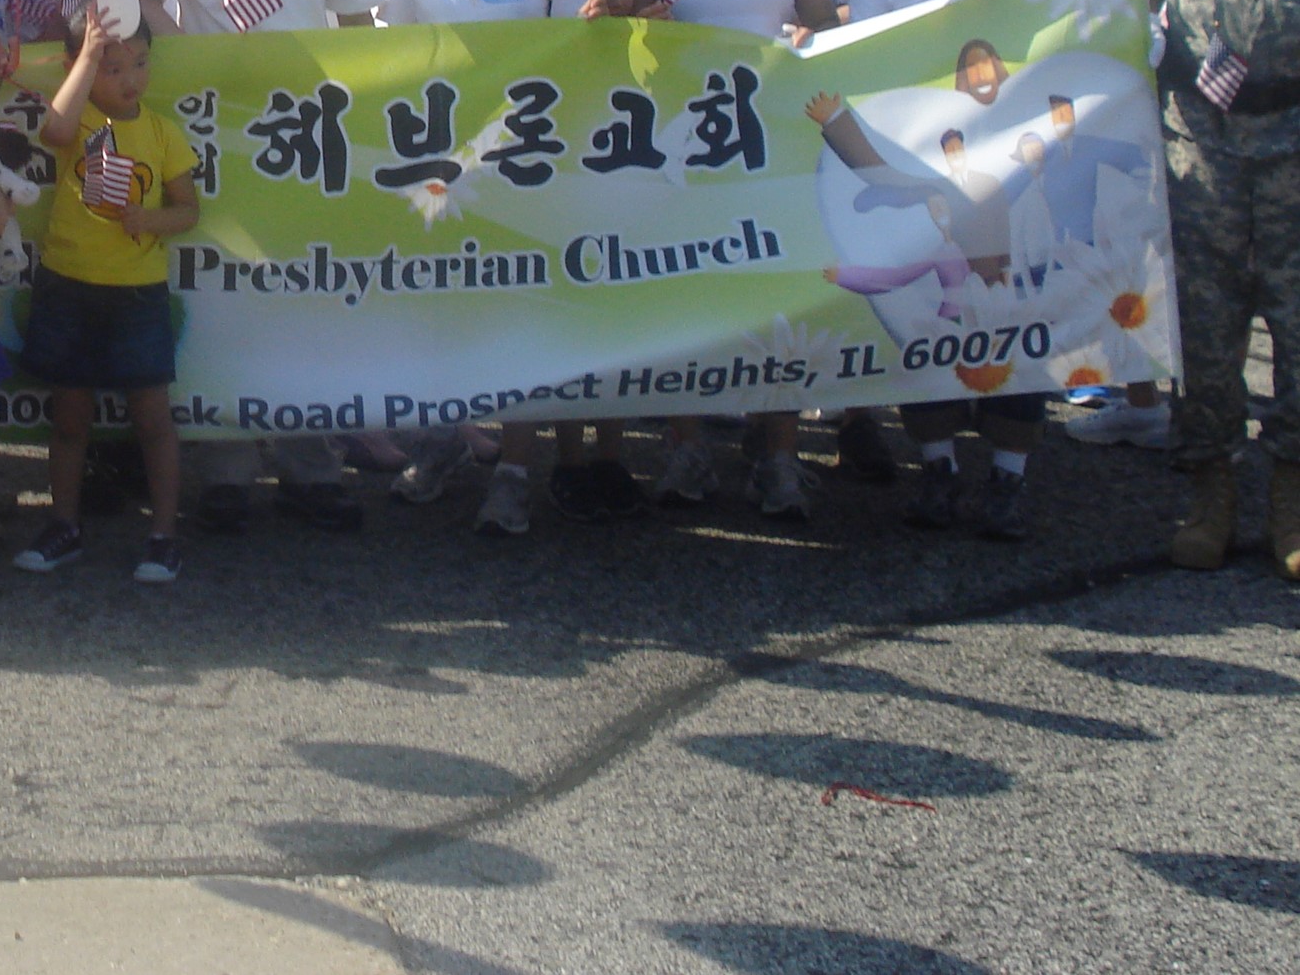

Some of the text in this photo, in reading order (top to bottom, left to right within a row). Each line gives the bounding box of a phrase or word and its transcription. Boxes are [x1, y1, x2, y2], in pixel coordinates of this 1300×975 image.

[247, 66, 766, 192] 헤브론교회
[177, 218, 782, 306] Presbyterian Church
[238, 395, 365, 431] Road
[384, 372, 602, 428] Prospect
[618, 356, 818, 397] Heights,
[836, 344, 886, 379] IL
[902, 322, 1051, 371] 60070
